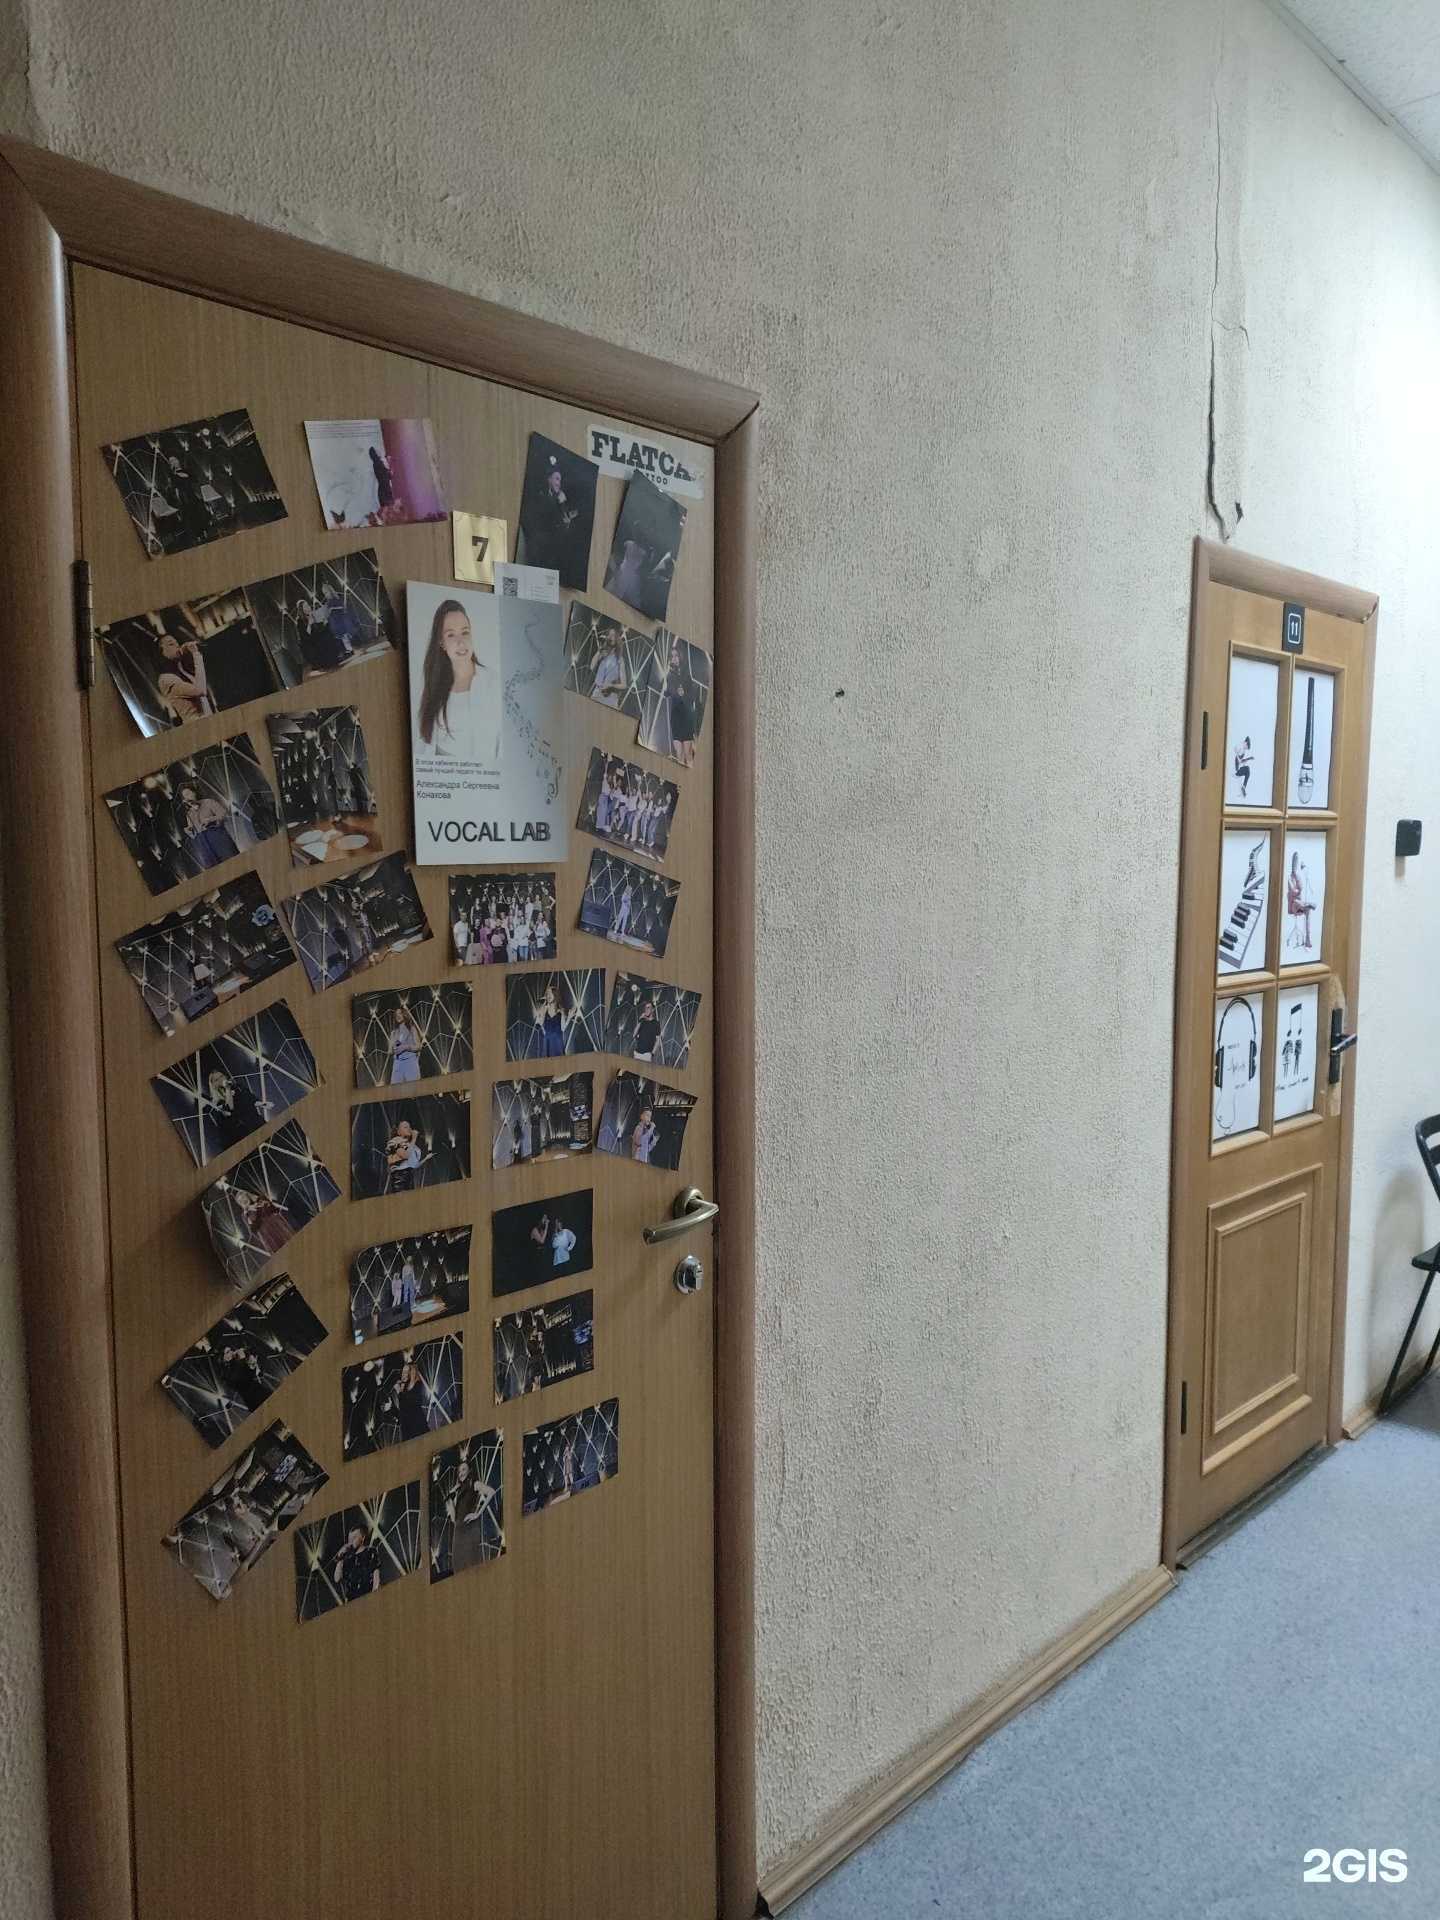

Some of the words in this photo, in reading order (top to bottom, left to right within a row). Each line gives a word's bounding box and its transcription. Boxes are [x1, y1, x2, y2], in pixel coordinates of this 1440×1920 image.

[591, 430, 697, 482] FLATCA
[471, 535, 489, 562] 7
[427, 820, 506, 842] VOCAL
[510, 821, 551, 842] LAB
